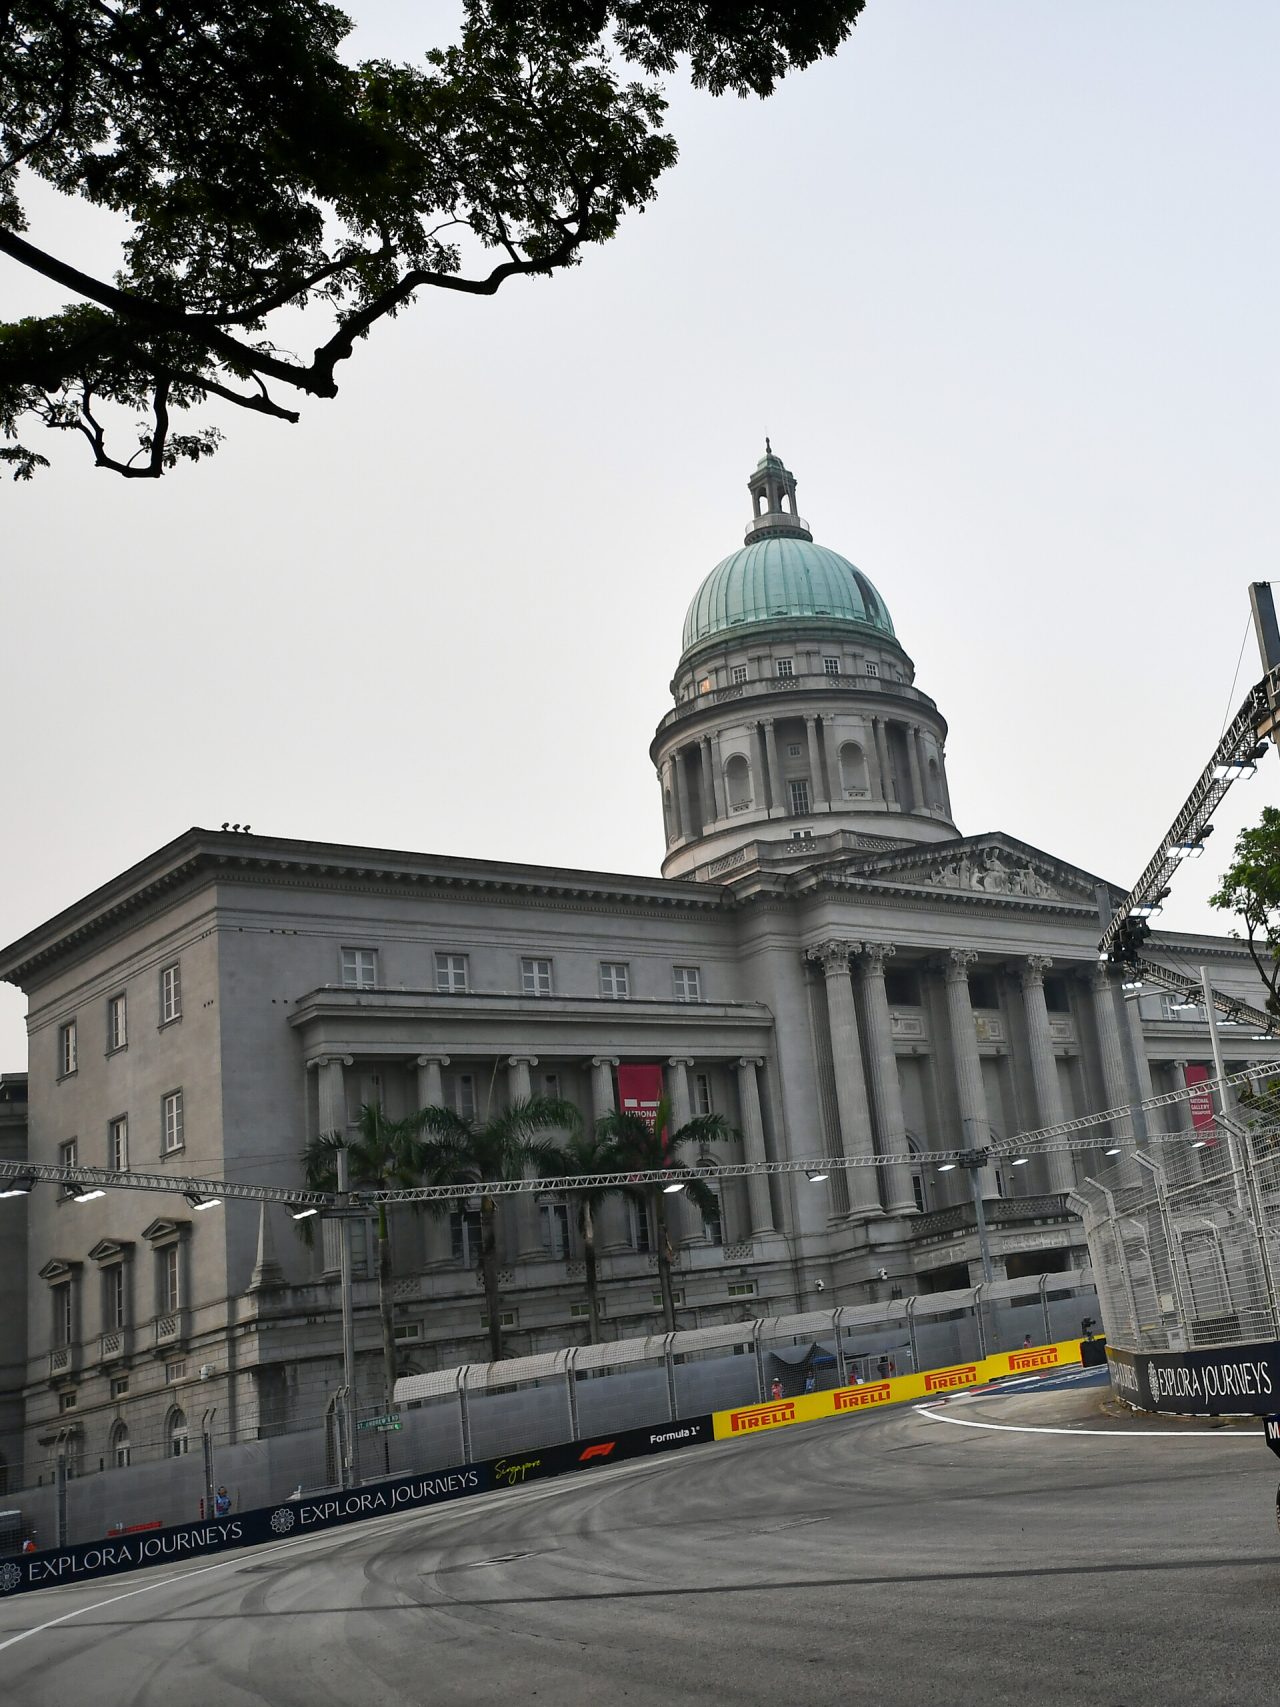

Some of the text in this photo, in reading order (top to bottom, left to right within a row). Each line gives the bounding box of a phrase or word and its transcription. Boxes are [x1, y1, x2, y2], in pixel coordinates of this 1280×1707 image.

[625, 1110, 657, 1118] TIONA
[1008, 1347, 1058, 1371] PIRELLI
[924, 1366, 977, 1391] PIRELLI
[1158, 1368, 1201, 1398] EXPLORA
[1201, 1361, 1272, 1405] JOURNEYS
[833, 1383, 890, 1410] PIRELLI
[730, 1402, 795, 1432] PIRELLI
[650, 1428, 689, 1445] Formula
[494, 1459, 541, 1485] Singapore
[300, 1471, 478, 1524] EXPLORA JOURNEYS
[28, 1521, 243, 1581] EXPLORA JOURNEYS
